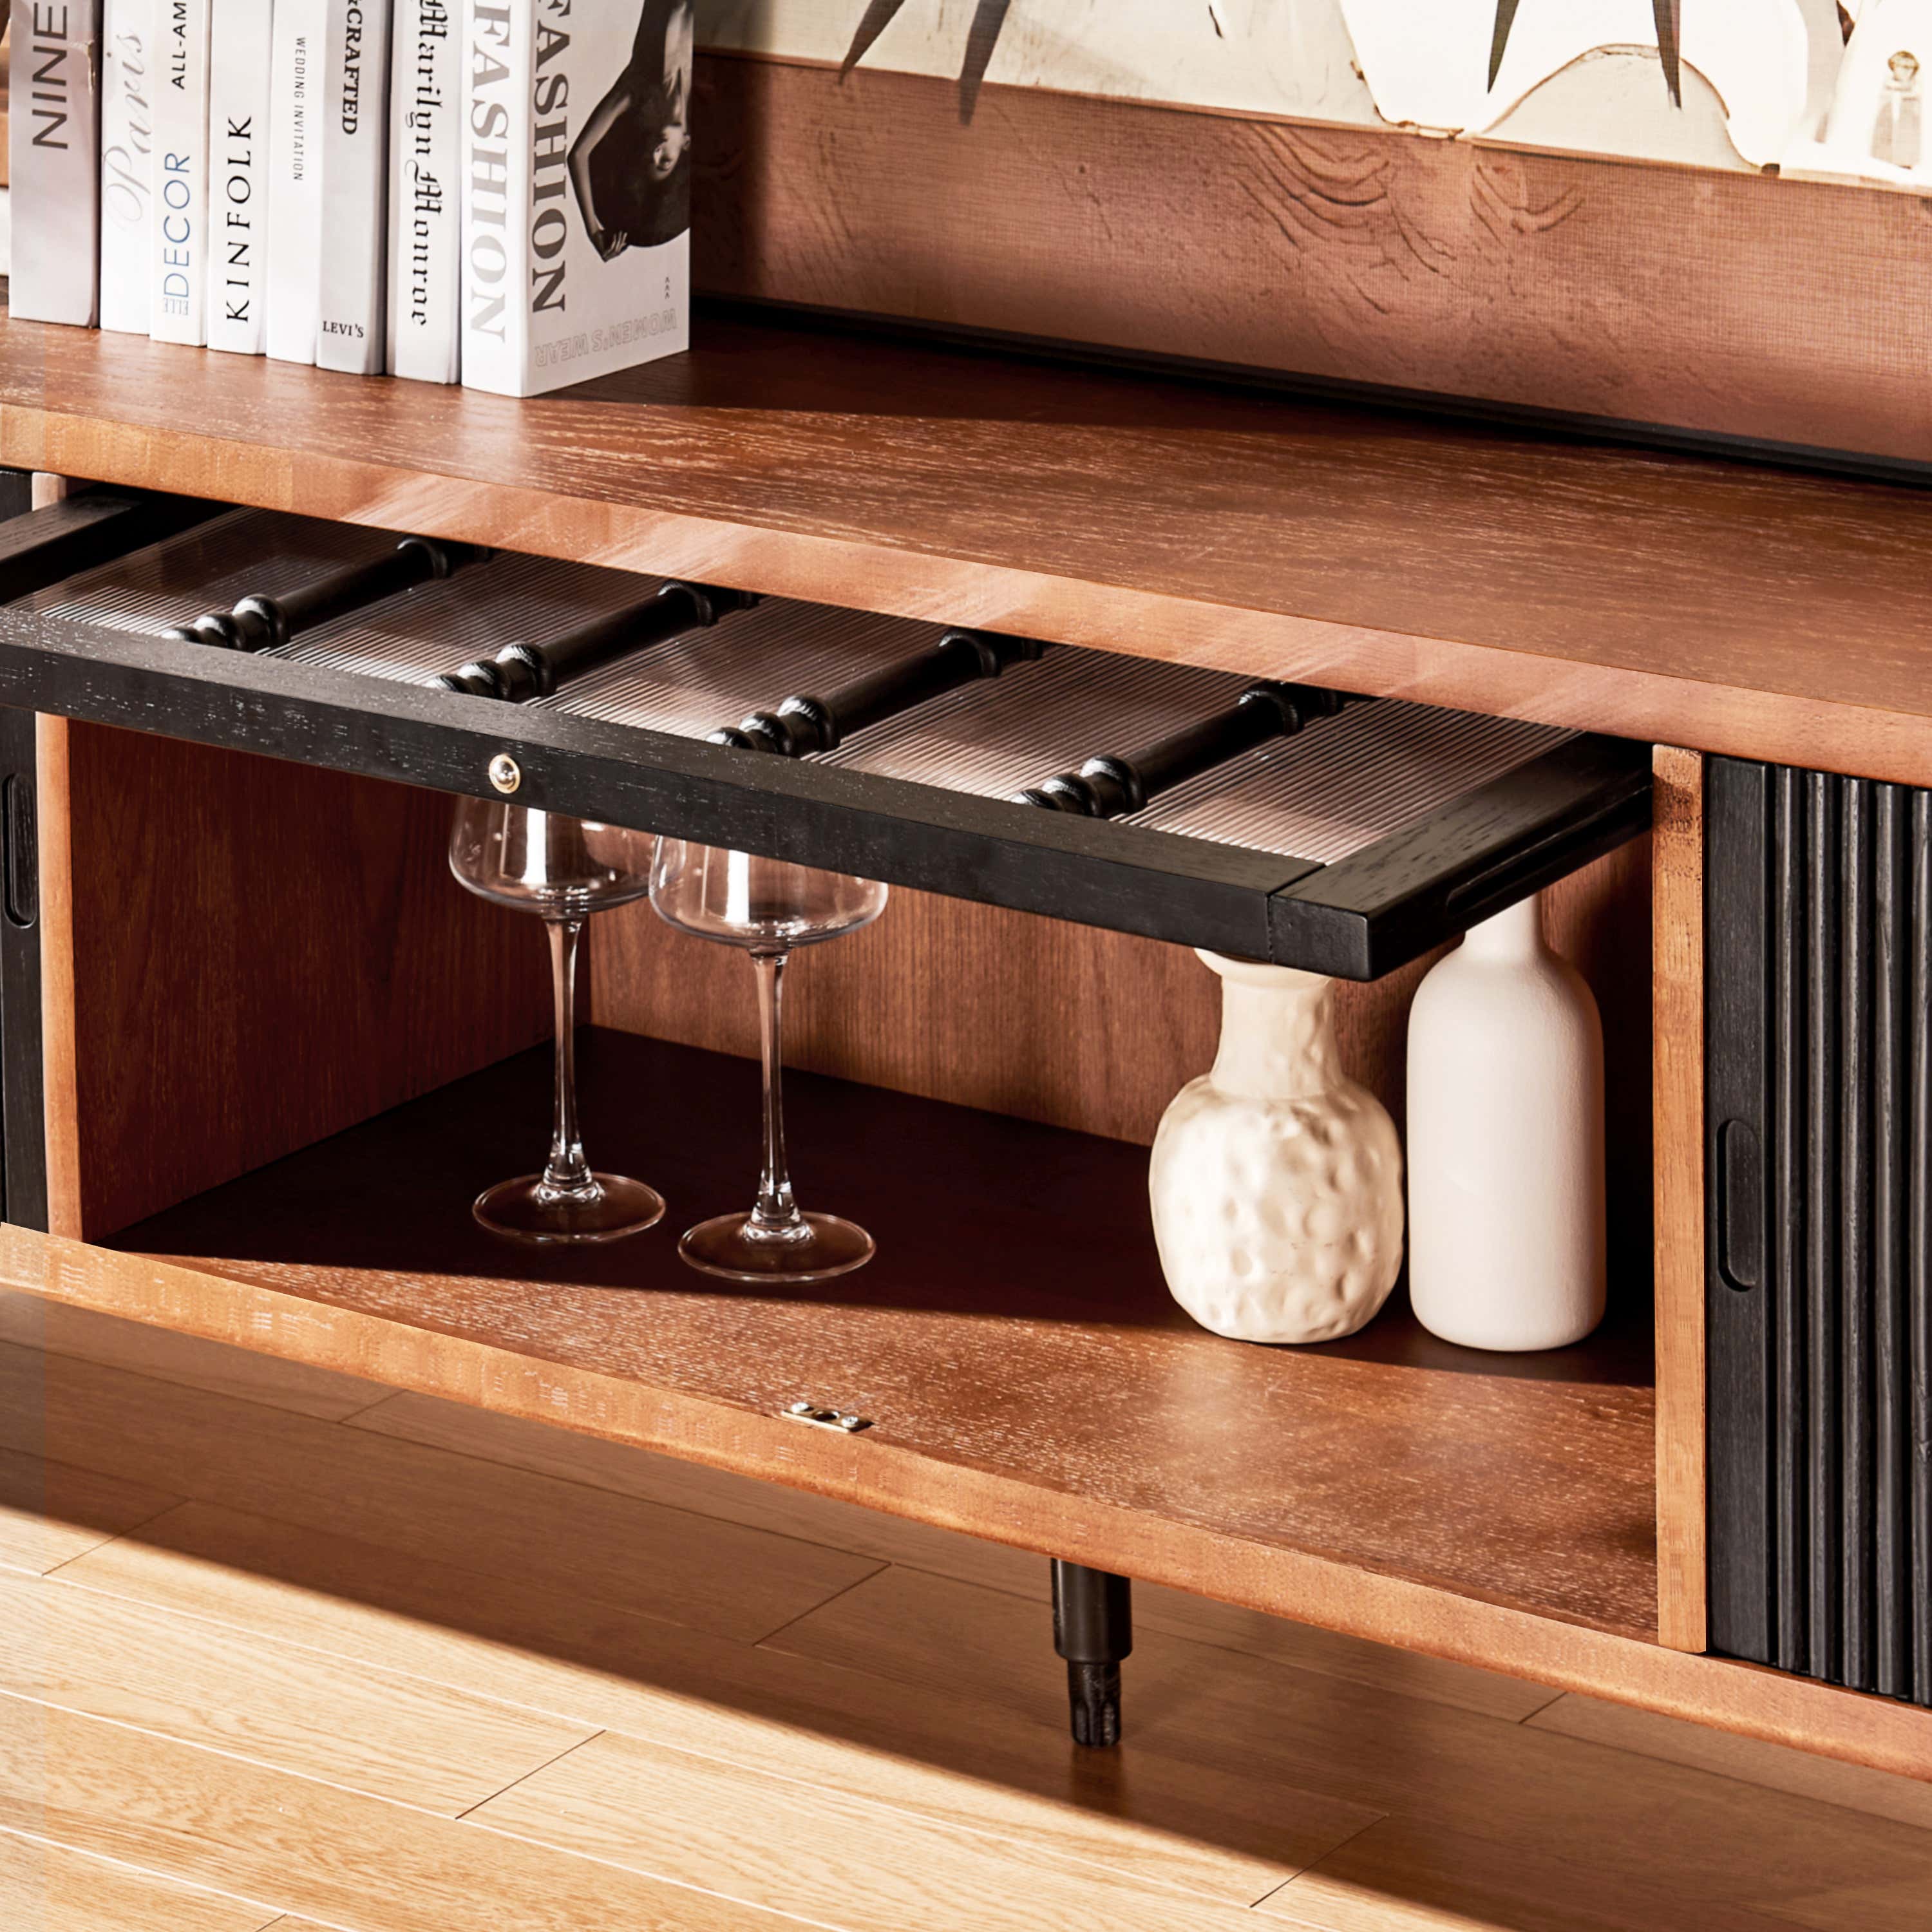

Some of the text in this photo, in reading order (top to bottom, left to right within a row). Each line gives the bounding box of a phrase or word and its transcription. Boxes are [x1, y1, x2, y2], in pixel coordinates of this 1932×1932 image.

[32, 2, 68, 150] NINE
[293, 37, 306, 181] WEDDING INVITATION
[164, 153, 190, 298] DECOR
[226, 116, 252, 323] KINFOLK
[405, 0, 448, 326] Marilyn Monroe
[470, 1, 511, 343] FASHION
[323, 320, 365, 339] LEVI'S
[535, 308, 677, 368] WOMEN'S WEAR
